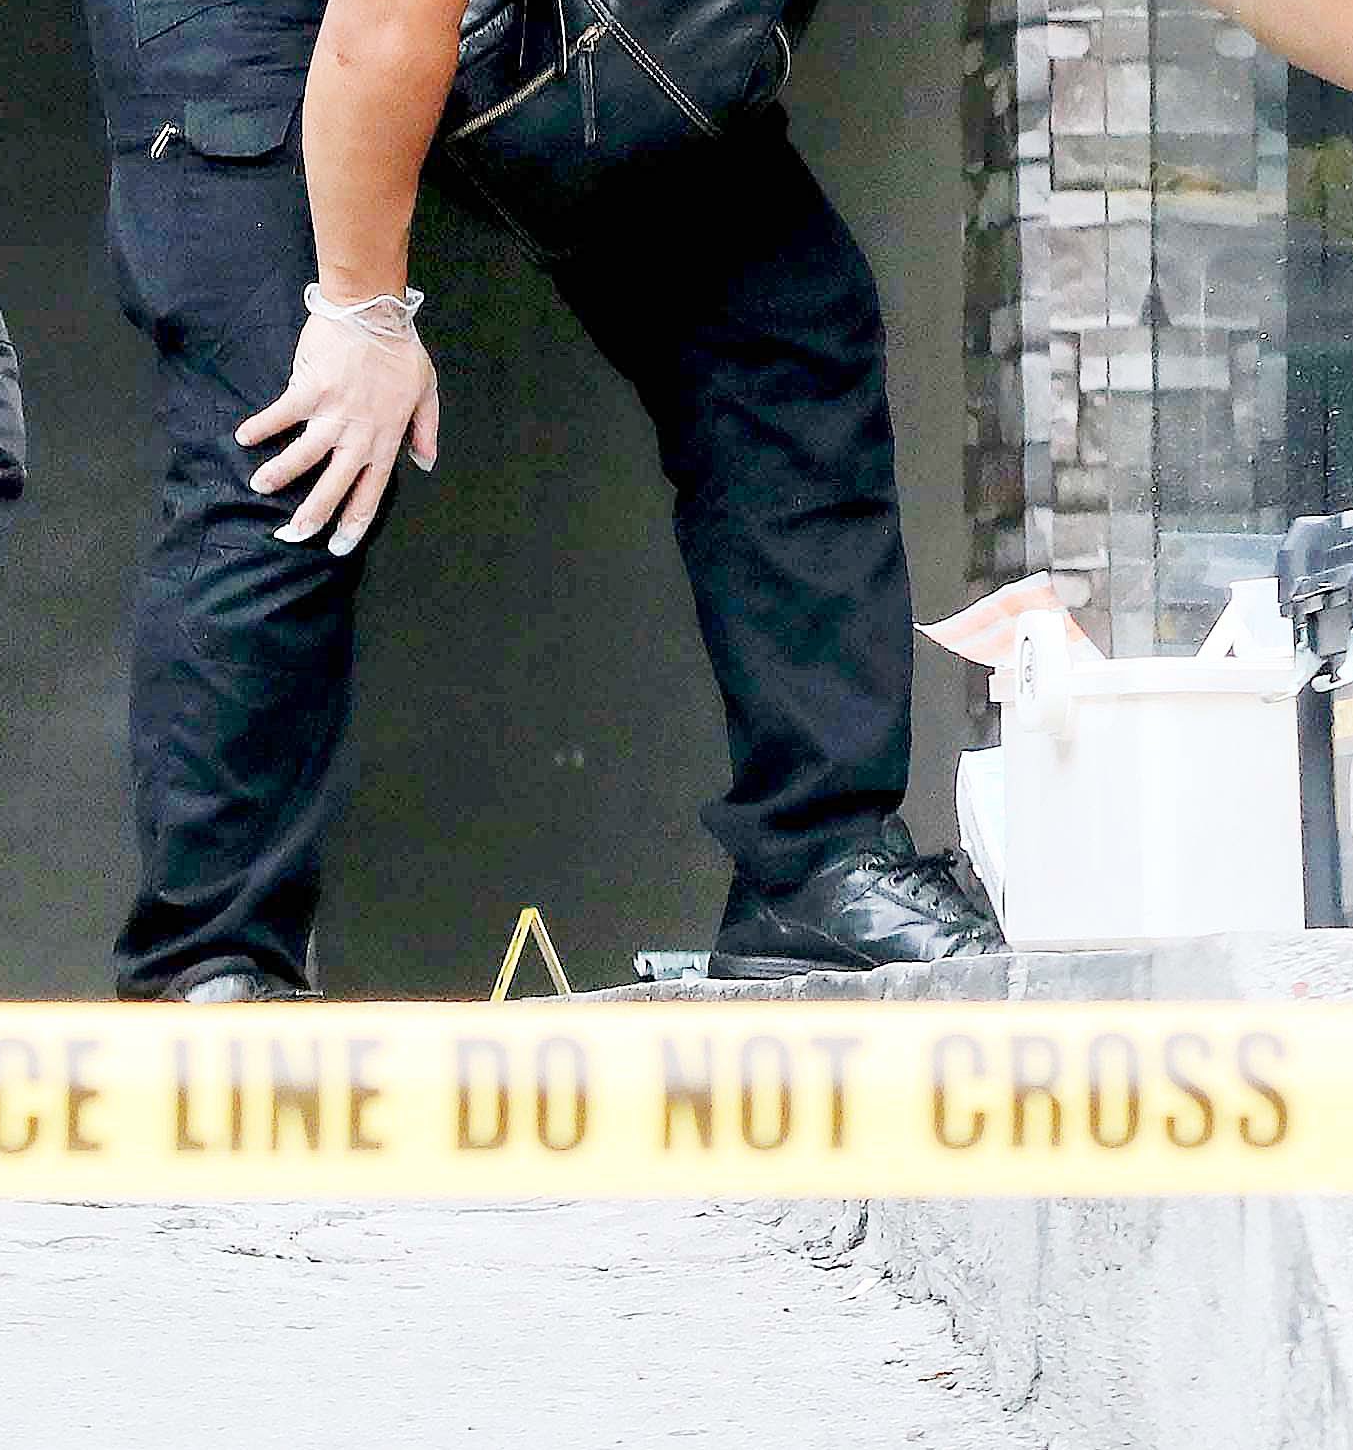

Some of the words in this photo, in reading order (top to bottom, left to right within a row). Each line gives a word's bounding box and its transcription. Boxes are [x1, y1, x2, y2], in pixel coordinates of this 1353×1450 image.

[173, 1036, 386, 1154] LINE
[454, 1035, 590, 1154] DO
[660, 1034, 861, 1153] NOT
[929, 1033, 1292, 1152] CROSS
